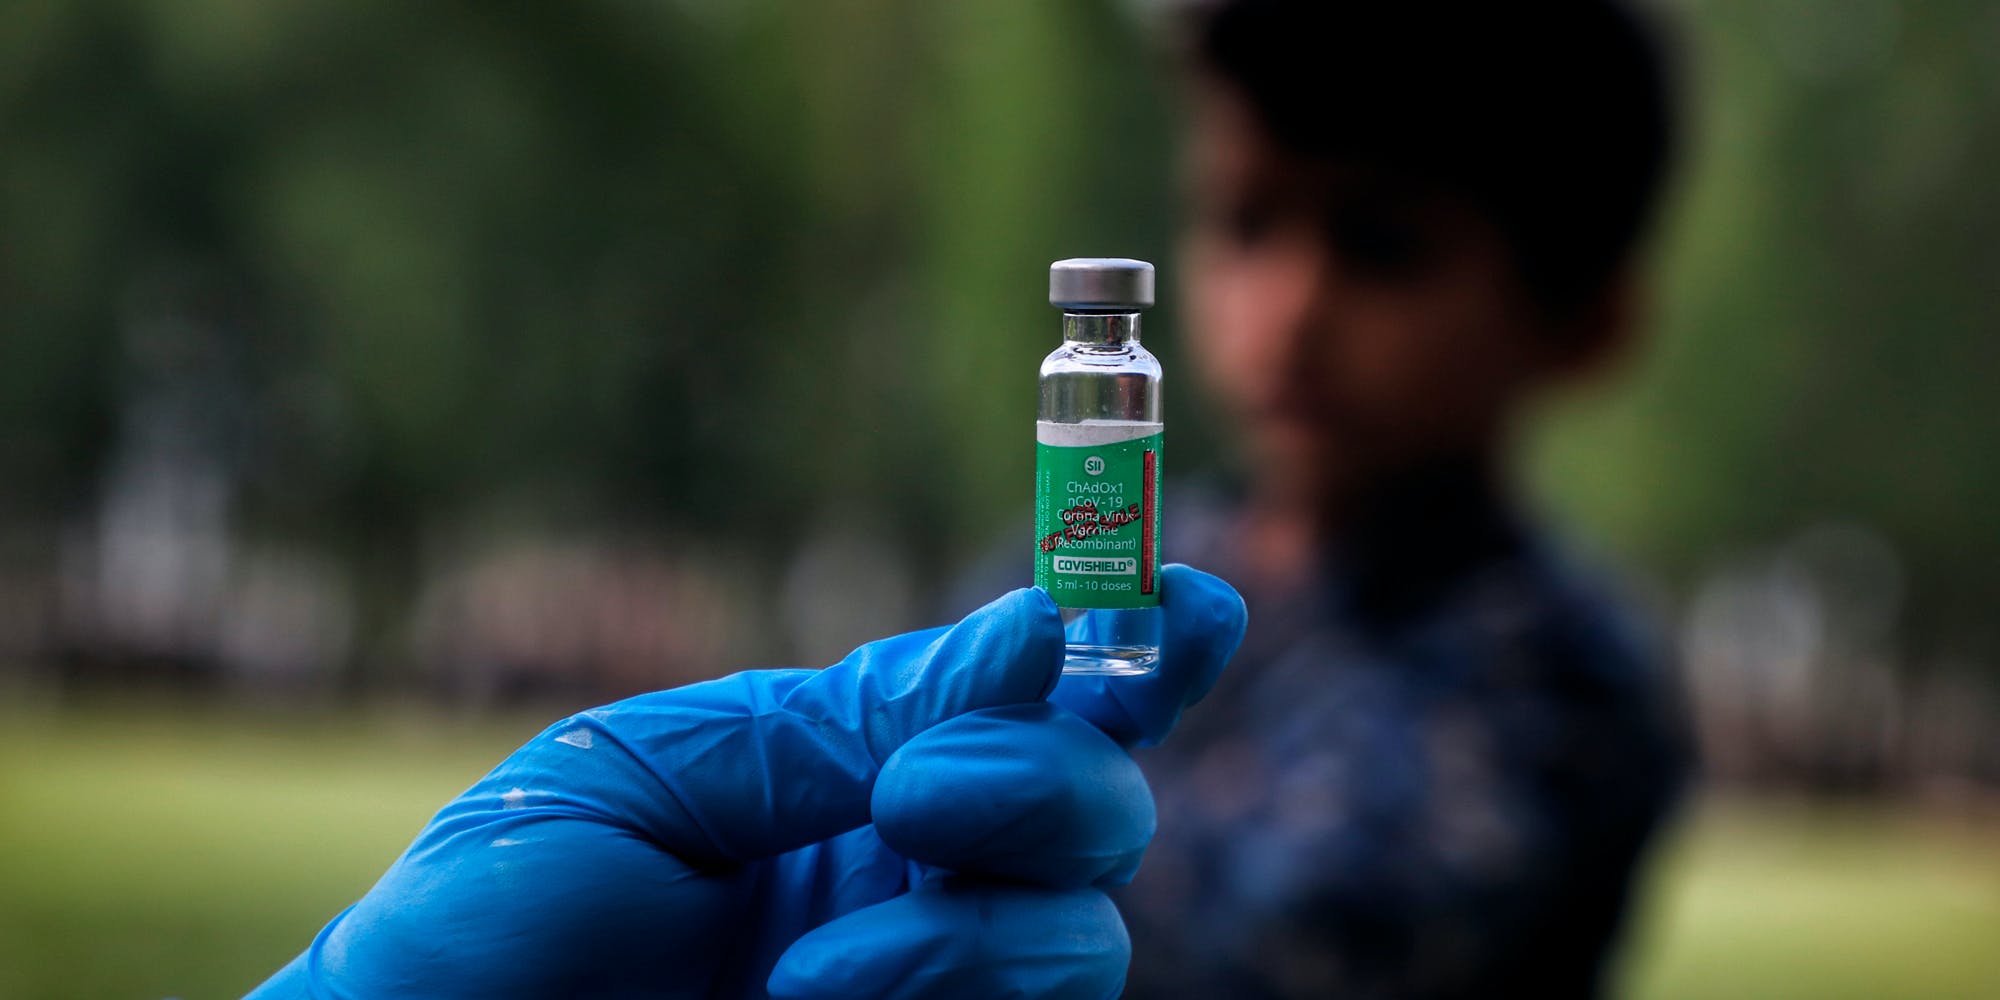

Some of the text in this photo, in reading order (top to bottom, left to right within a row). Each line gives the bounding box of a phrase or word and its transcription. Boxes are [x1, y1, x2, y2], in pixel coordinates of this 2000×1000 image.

[1066, 481, 1123, 494] ChAdOx1
[1057, 509, 1135, 522] Corona Virus
[1071, 523, 1118, 536] Vaccine
[1054, 537, 1136, 550] (Recombinant)
[1057, 580, 1063, 589] 5
[1065, 580, 1077, 589] ml
[1085, 580, 1098, 590] 10
[1101, 580, 1132, 591] doses
